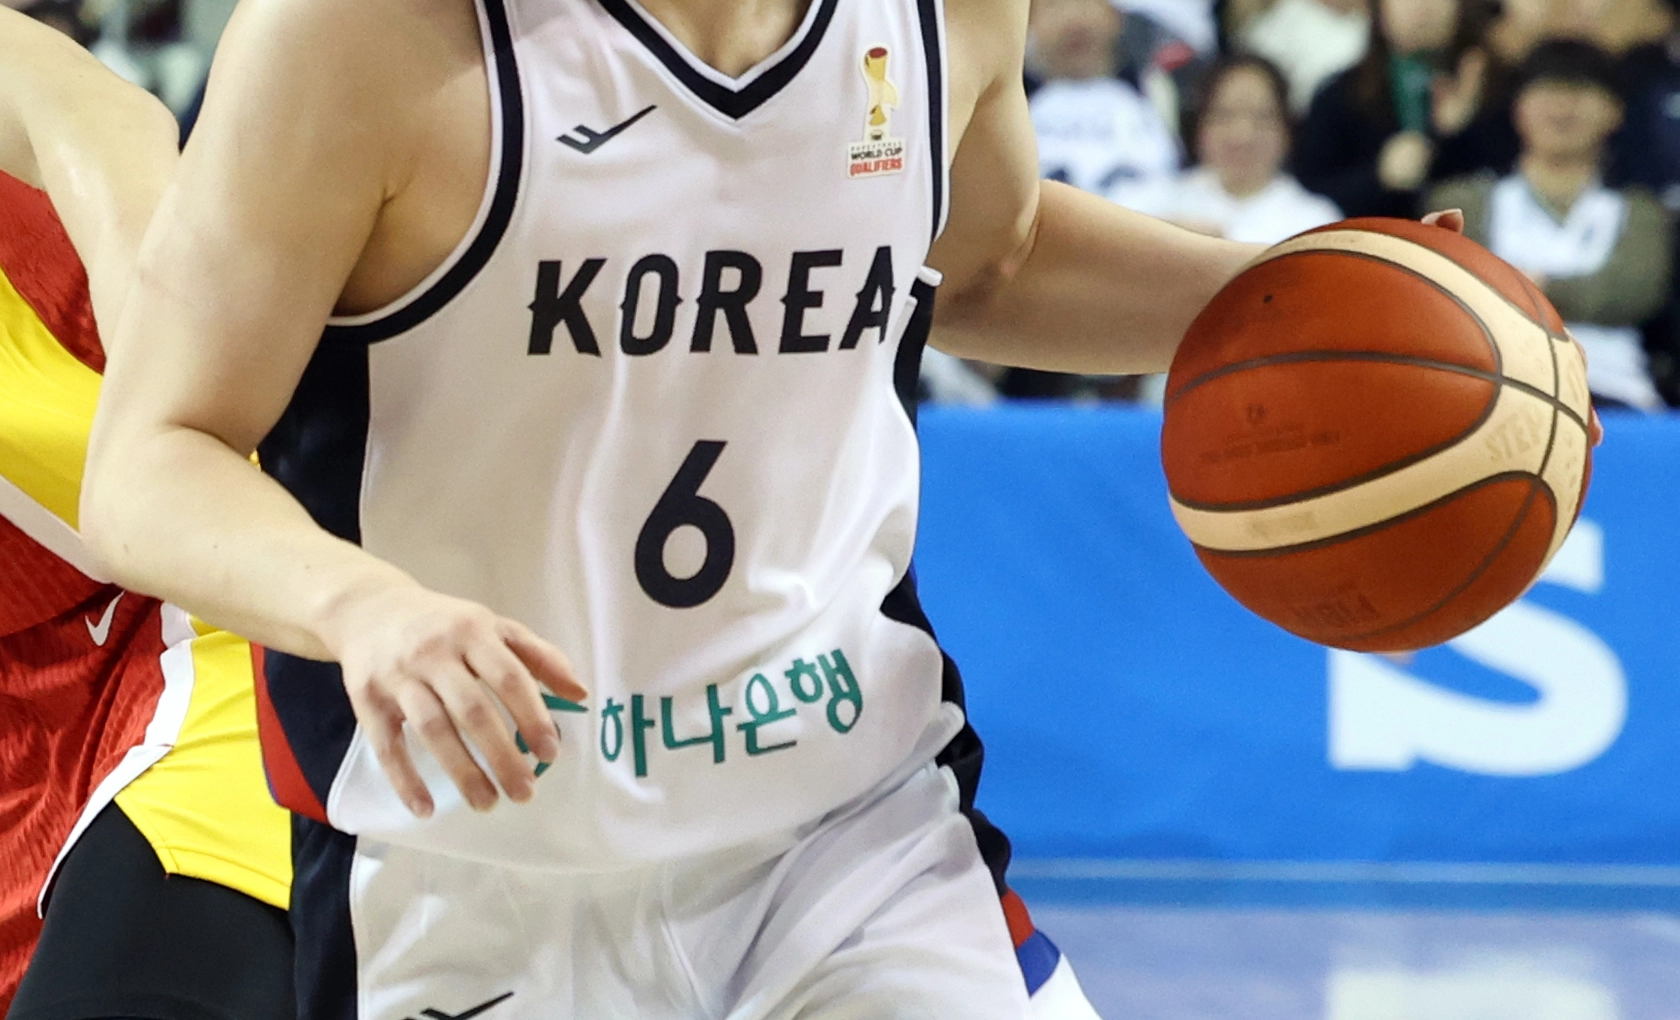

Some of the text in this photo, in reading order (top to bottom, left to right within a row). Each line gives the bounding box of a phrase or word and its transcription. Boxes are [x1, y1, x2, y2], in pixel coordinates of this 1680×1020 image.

[850, 158, 902, 176] QUALIFIERS
[851, 147, 902, 160] WORLD CUP
[527, 245, 895, 358] KOREA
[634, 440, 735, 608] 6
[600, 648, 863, 778] 하나은행
